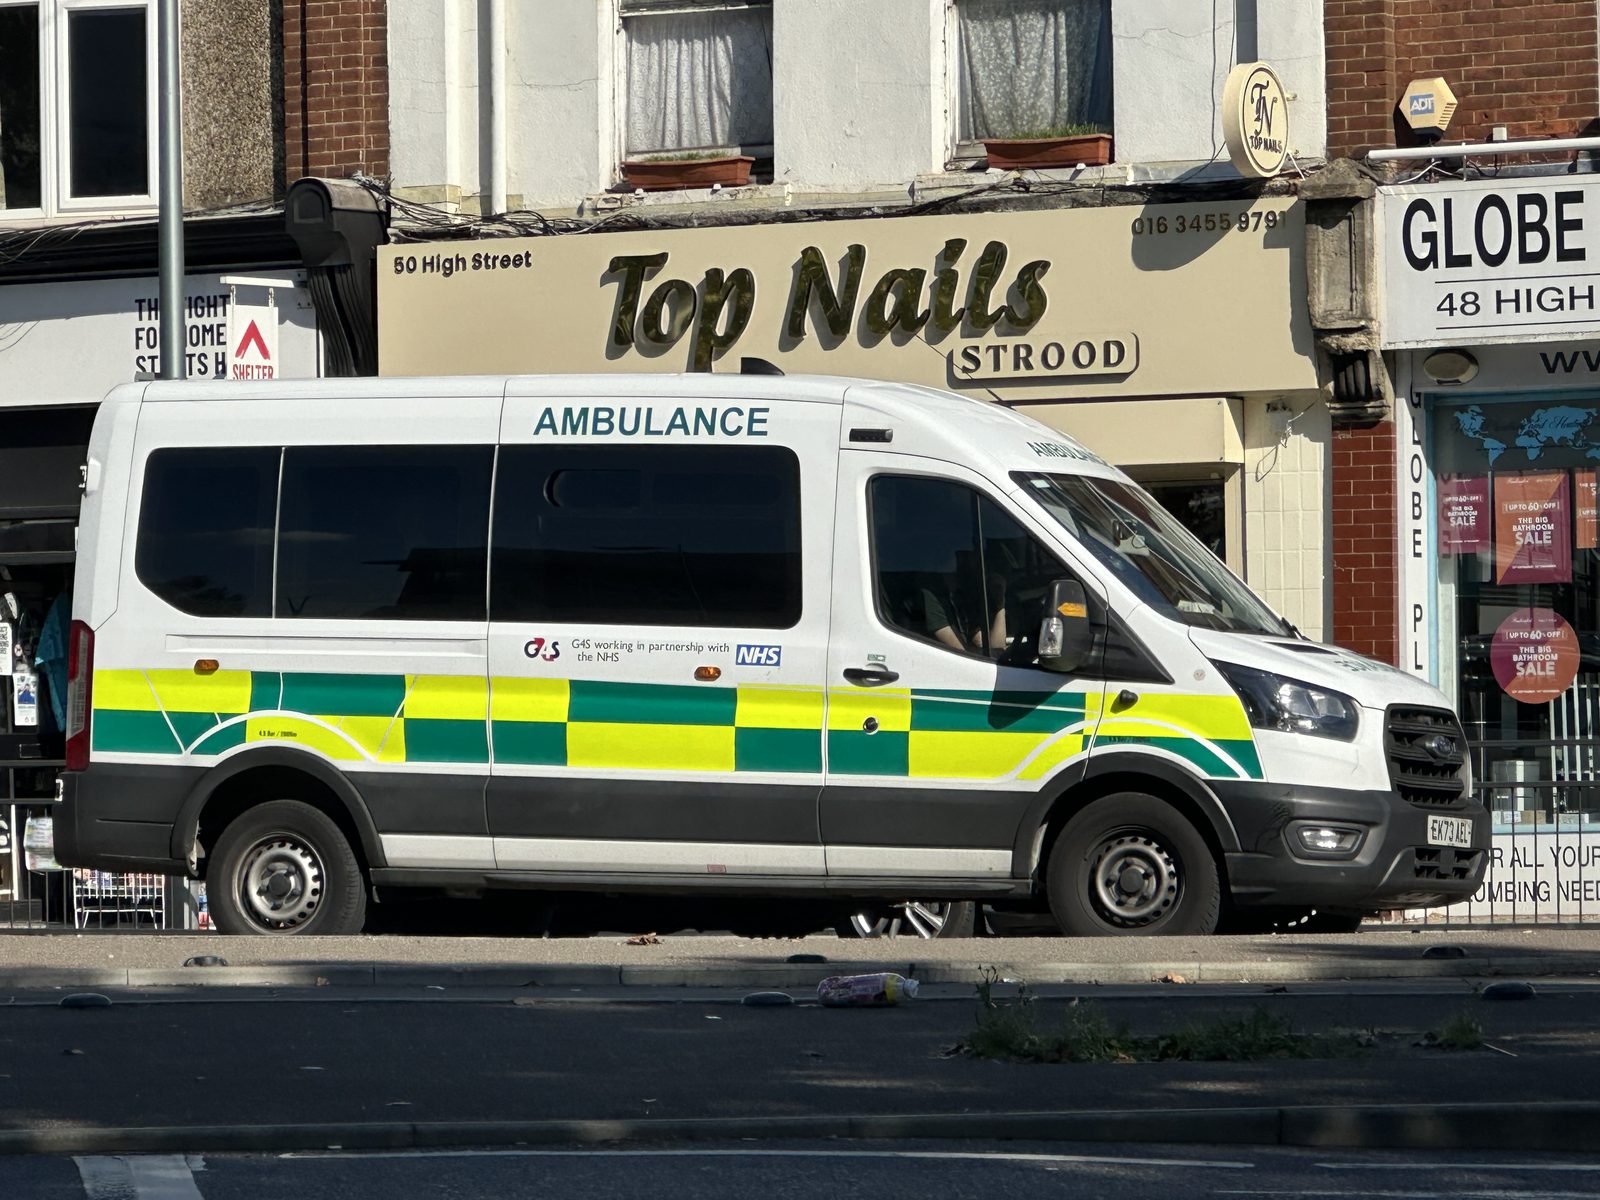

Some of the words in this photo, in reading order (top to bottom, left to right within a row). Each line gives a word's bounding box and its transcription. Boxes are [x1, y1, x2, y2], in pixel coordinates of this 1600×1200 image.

[1410, 96, 1434, 111] ADT
[1250, 135, 1263, 150] TOP
[1264, 137, 1283, 154] NAILS
[1131, 216, 1168, 235] 016
[1175, 213, 1231, 233] 3455
[1402, 190, 1586, 271] GLOBE
[394, 256, 417, 274] 50
[422, 253, 467, 278] High
[471, 250, 532, 270] Street
[135, 298, 159, 321] TH
[185, 294, 230, 318] IGHT
[606, 251, 756, 373] Top
[787, 238, 1051, 337] Nails
[1436, 291, 1481, 317] 48
[1496, 285, 1594, 314] HIGH
[135, 327, 158, 350] FO
[185, 323, 226, 347] OME
[135, 352, 208, 377] STTS
[961, 339, 1127, 374] STROOD
[233, 364, 274, 379] SHELTER
[533, 407, 770, 436] AMBULANCE
[1450, 516, 1476, 527] SALE
[1512, 524, 1554, 532] BATHROOM
[1535, 516, 1548, 524] BIG
[1515, 531, 1552, 545] SALE
[1509, 631, 1519, 639] UP
[1520, 631, 1529, 639] TO
[1547, 630, 1560, 638] OFF
[524, 637, 560, 662] G4S
[571, 639, 591, 649] G4S
[594, 641, 633, 653] working
[637, 641, 645, 651] in
[648, 642, 704, 654] partnership
[707, 643, 730, 653] with
[737, 646, 780, 665] NHS
[1519, 646, 1535, 654] THE
[1538, 645, 1552, 653] BIG
[577, 652, 593, 662] the
[597, 653, 620, 662] NHS
[1512, 653, 1558, 662] BATHROOM
[1516, 661, 1556, 676] SALE
[1431, 819, 1454, 842] EK73
[1510, 846, 1545, 868] ALL
[1550, 845, 1600, 867] YOUR
[1470, 880, 1551, 902] UMBING
[1557, 880, 1600, 902] NEE
